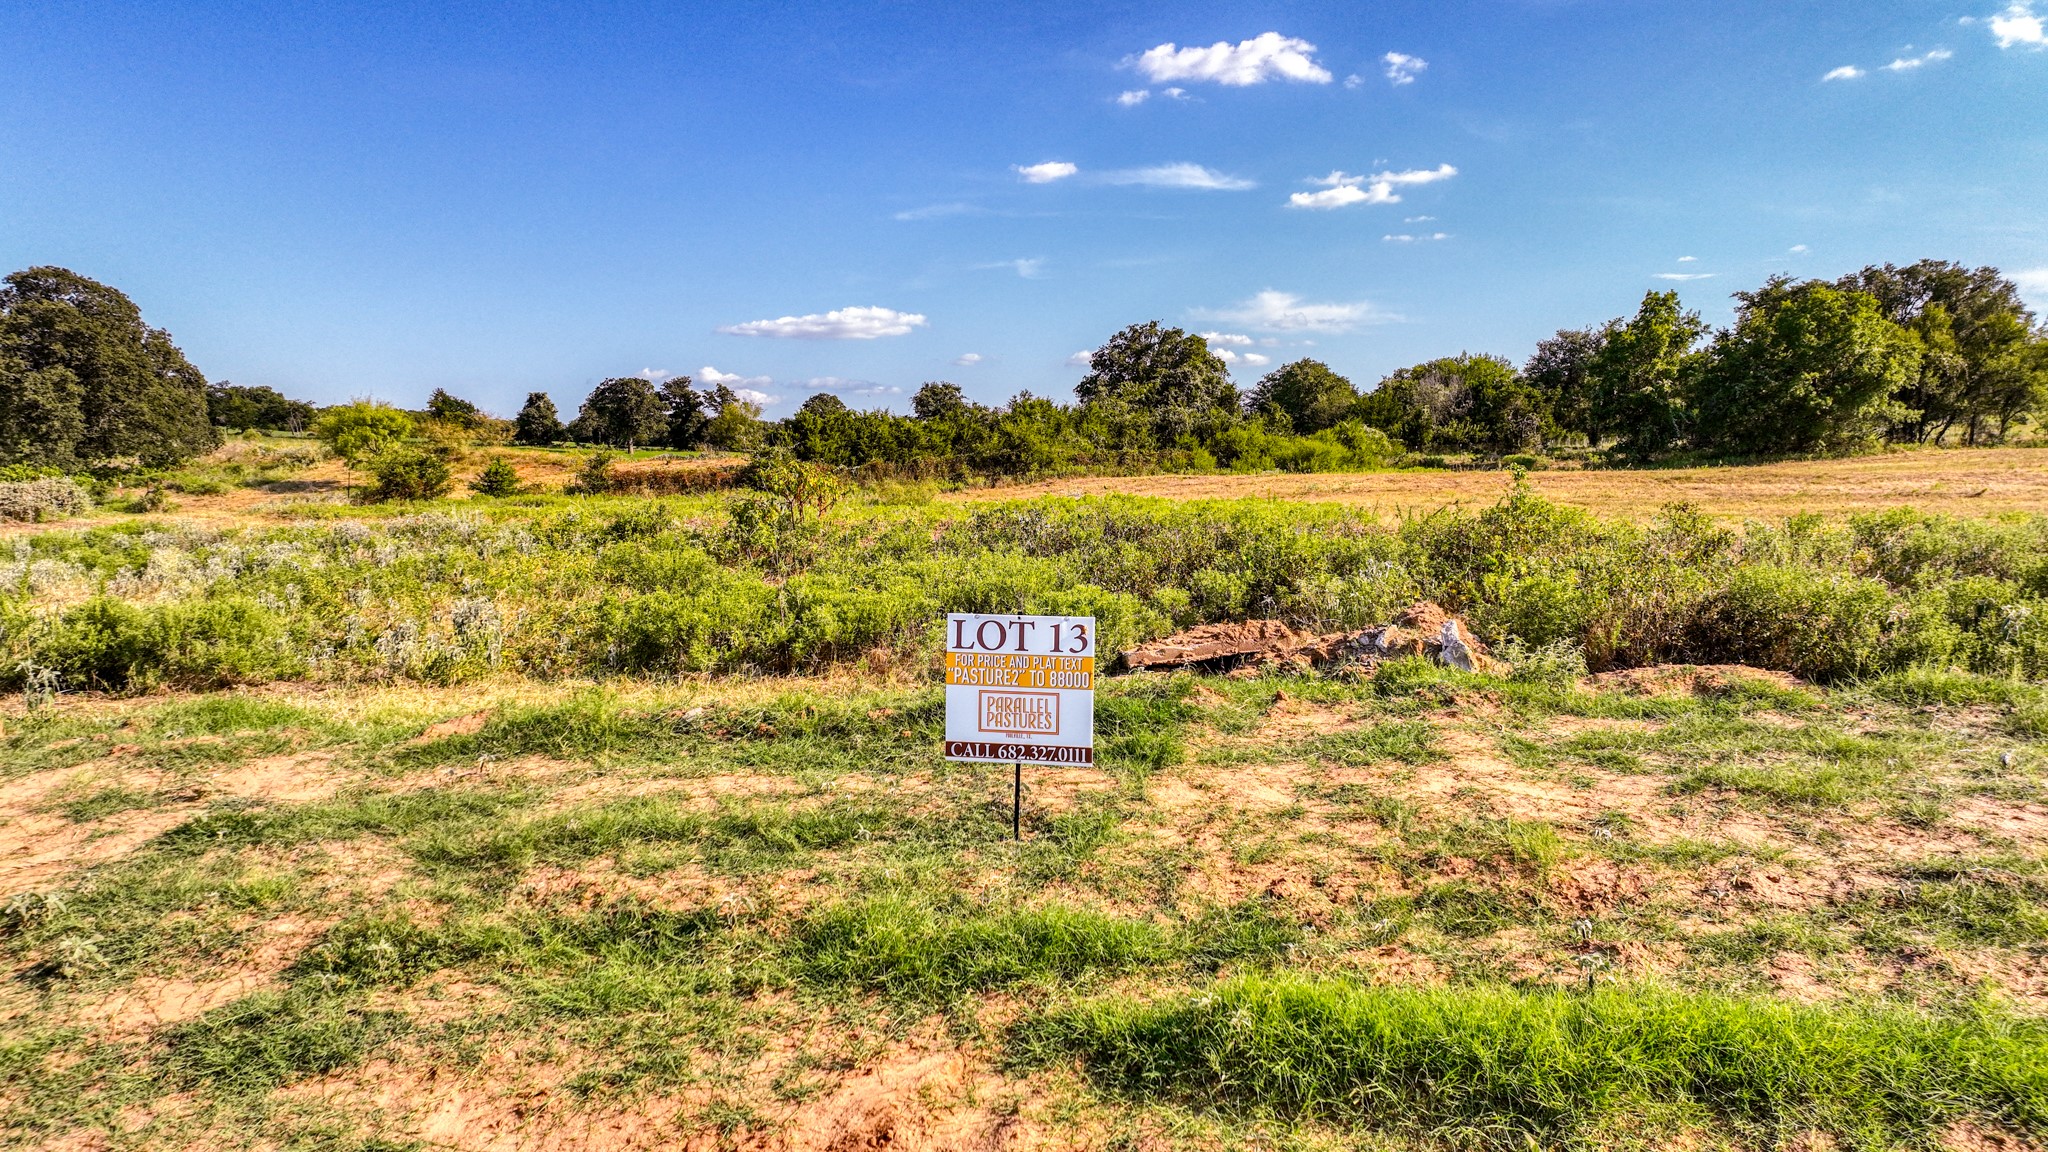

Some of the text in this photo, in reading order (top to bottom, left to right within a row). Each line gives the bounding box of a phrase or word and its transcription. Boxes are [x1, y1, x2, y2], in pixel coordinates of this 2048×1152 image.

[952, 619, 1088, 653] LOT 13
[955, 654, 1082, 670] FOR PRICE AND PLAT TEXT
[1029, 670, 1045, 687] TO
[1050, 671, 1090, 688] 88000
[987, 696, 1052, 715] PARALLEL
[986, 711, 1052, 730] PASTURES
[951, 743, 1086, 762] CALL 682.327.0111
